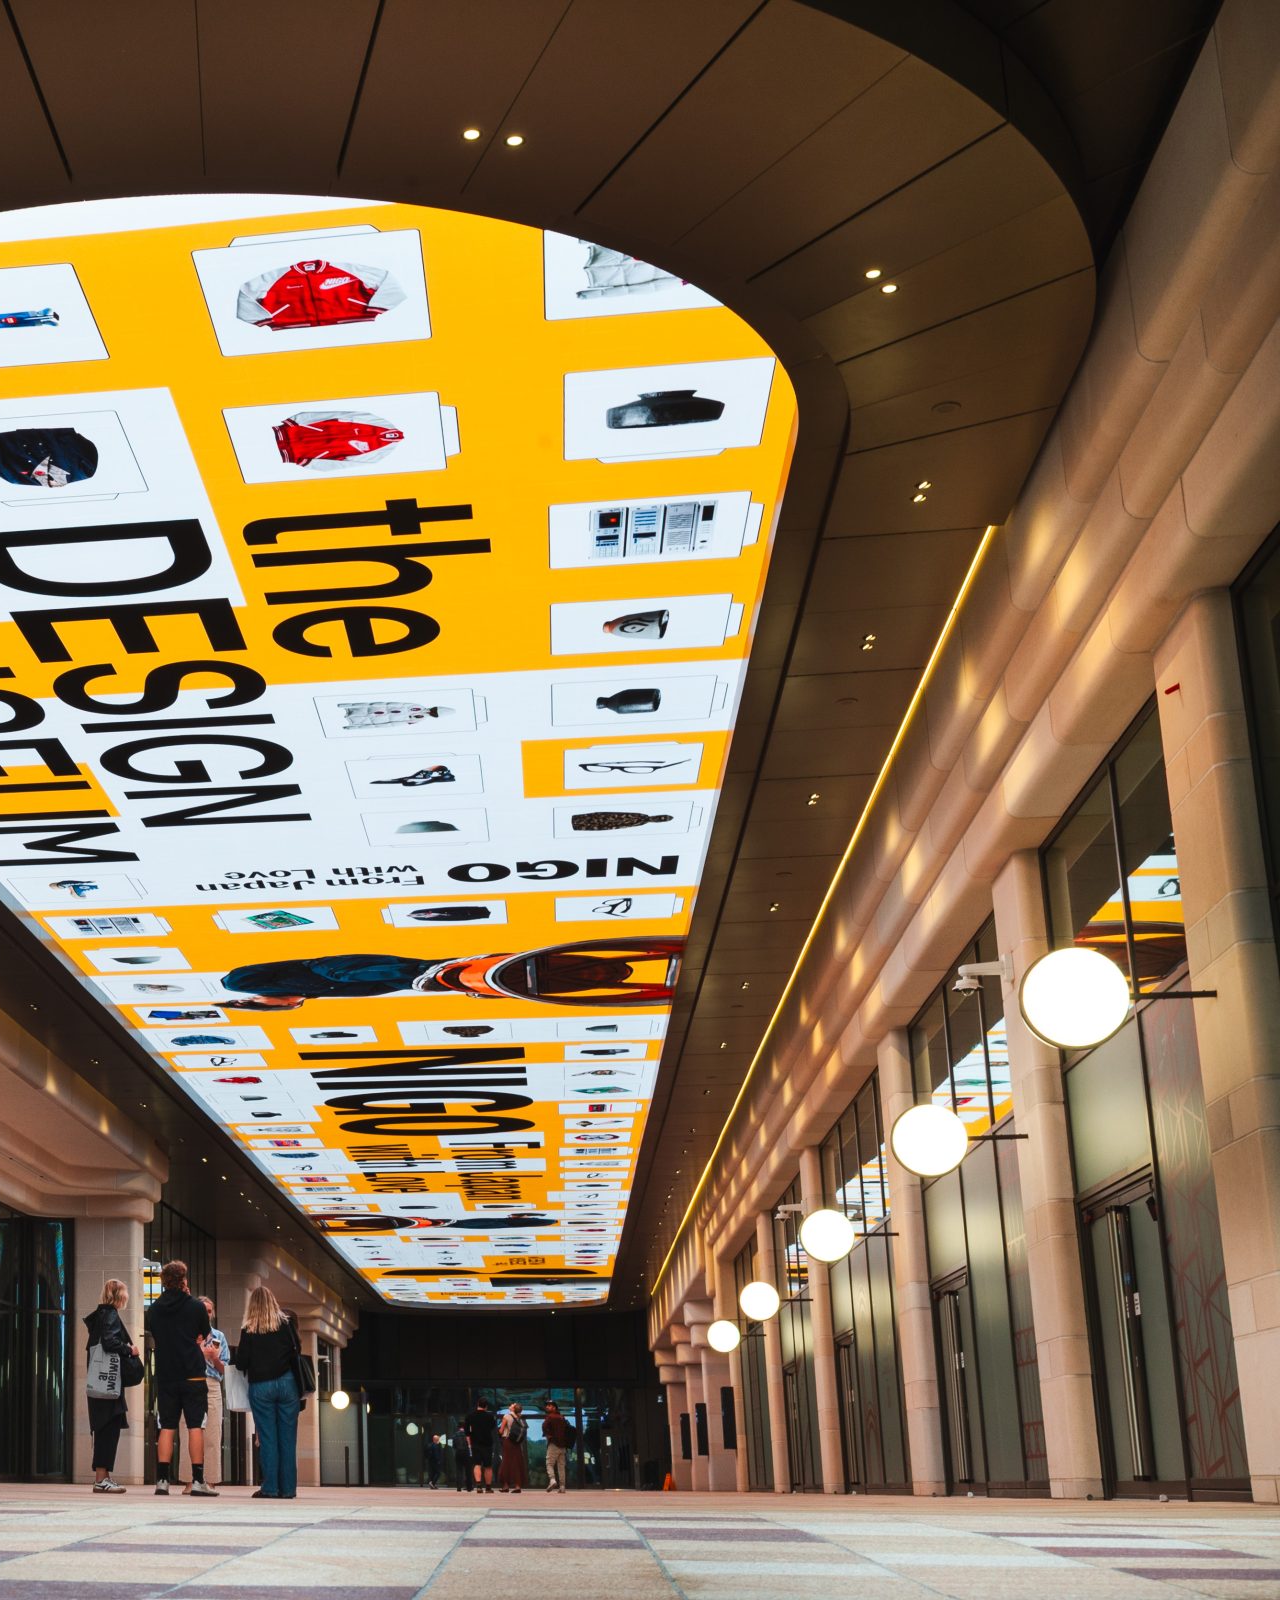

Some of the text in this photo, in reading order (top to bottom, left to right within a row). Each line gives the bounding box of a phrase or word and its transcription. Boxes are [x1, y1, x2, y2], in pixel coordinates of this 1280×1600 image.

[243, 498, 491, 658] the
[224, 865, 418, 880] with Love
[448, 855, 679, 883] NIGO
[195, 875, 425, 892] From Japan
[298, 1047, 536, 1136] NIGO
[347, 1144, 445, 1193] with Love
[449, 1141, 541, 1170] From
[445, 1172, 543, 1200] Japan
